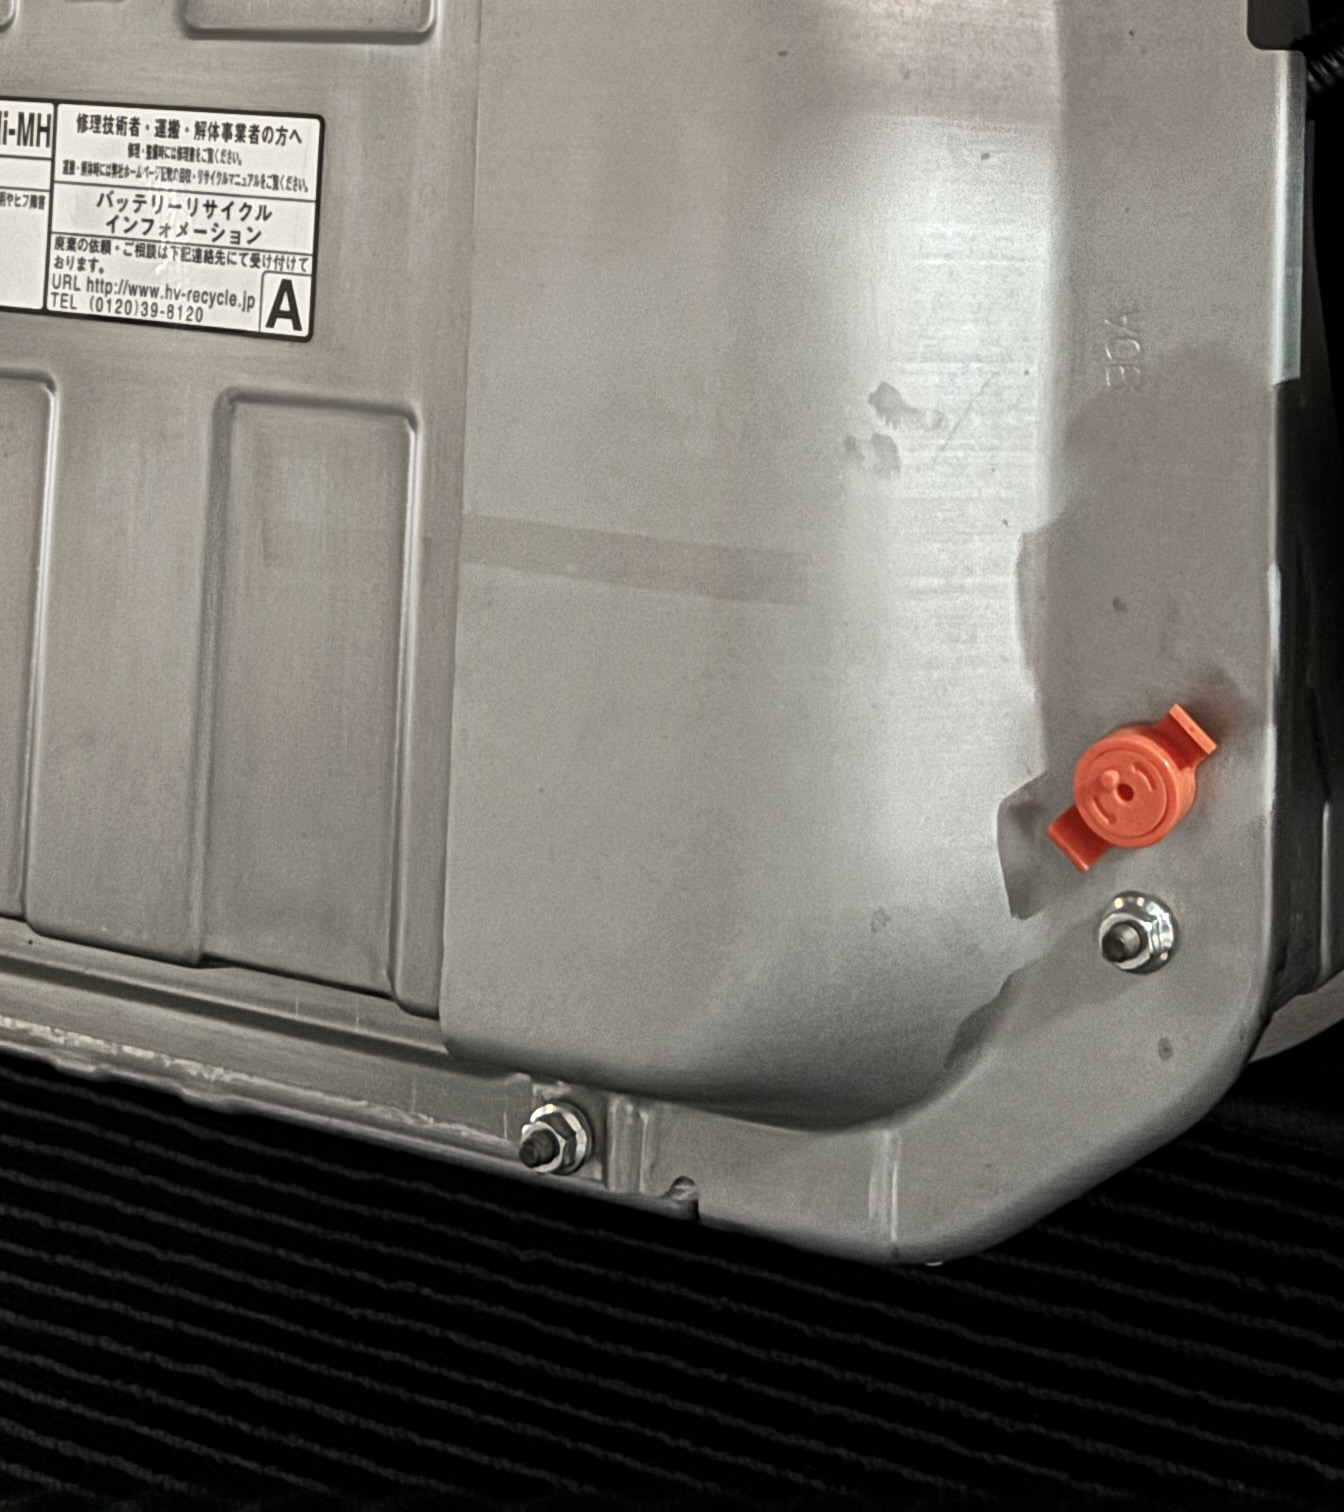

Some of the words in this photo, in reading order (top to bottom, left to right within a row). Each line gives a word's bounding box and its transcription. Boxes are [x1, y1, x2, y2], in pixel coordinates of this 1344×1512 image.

[96, 190, 273, 223] バッテリーリサイクル
[106, 215, 262, 246] インフォメーション
[53, 236, 310, 272] 廃棄の依頼・ご相談は下記連絡先にて受け付けて
[53, 255, 105, 274] おります。
[50, 291, 78, 310] TEL
[88, 294, 204, 323] (0120)39-8120
[51, 273, 81, 291] URL
[86, 275, 256, 312] http://www.hv-recycle.jp
[264, 278, 303, 332] A
